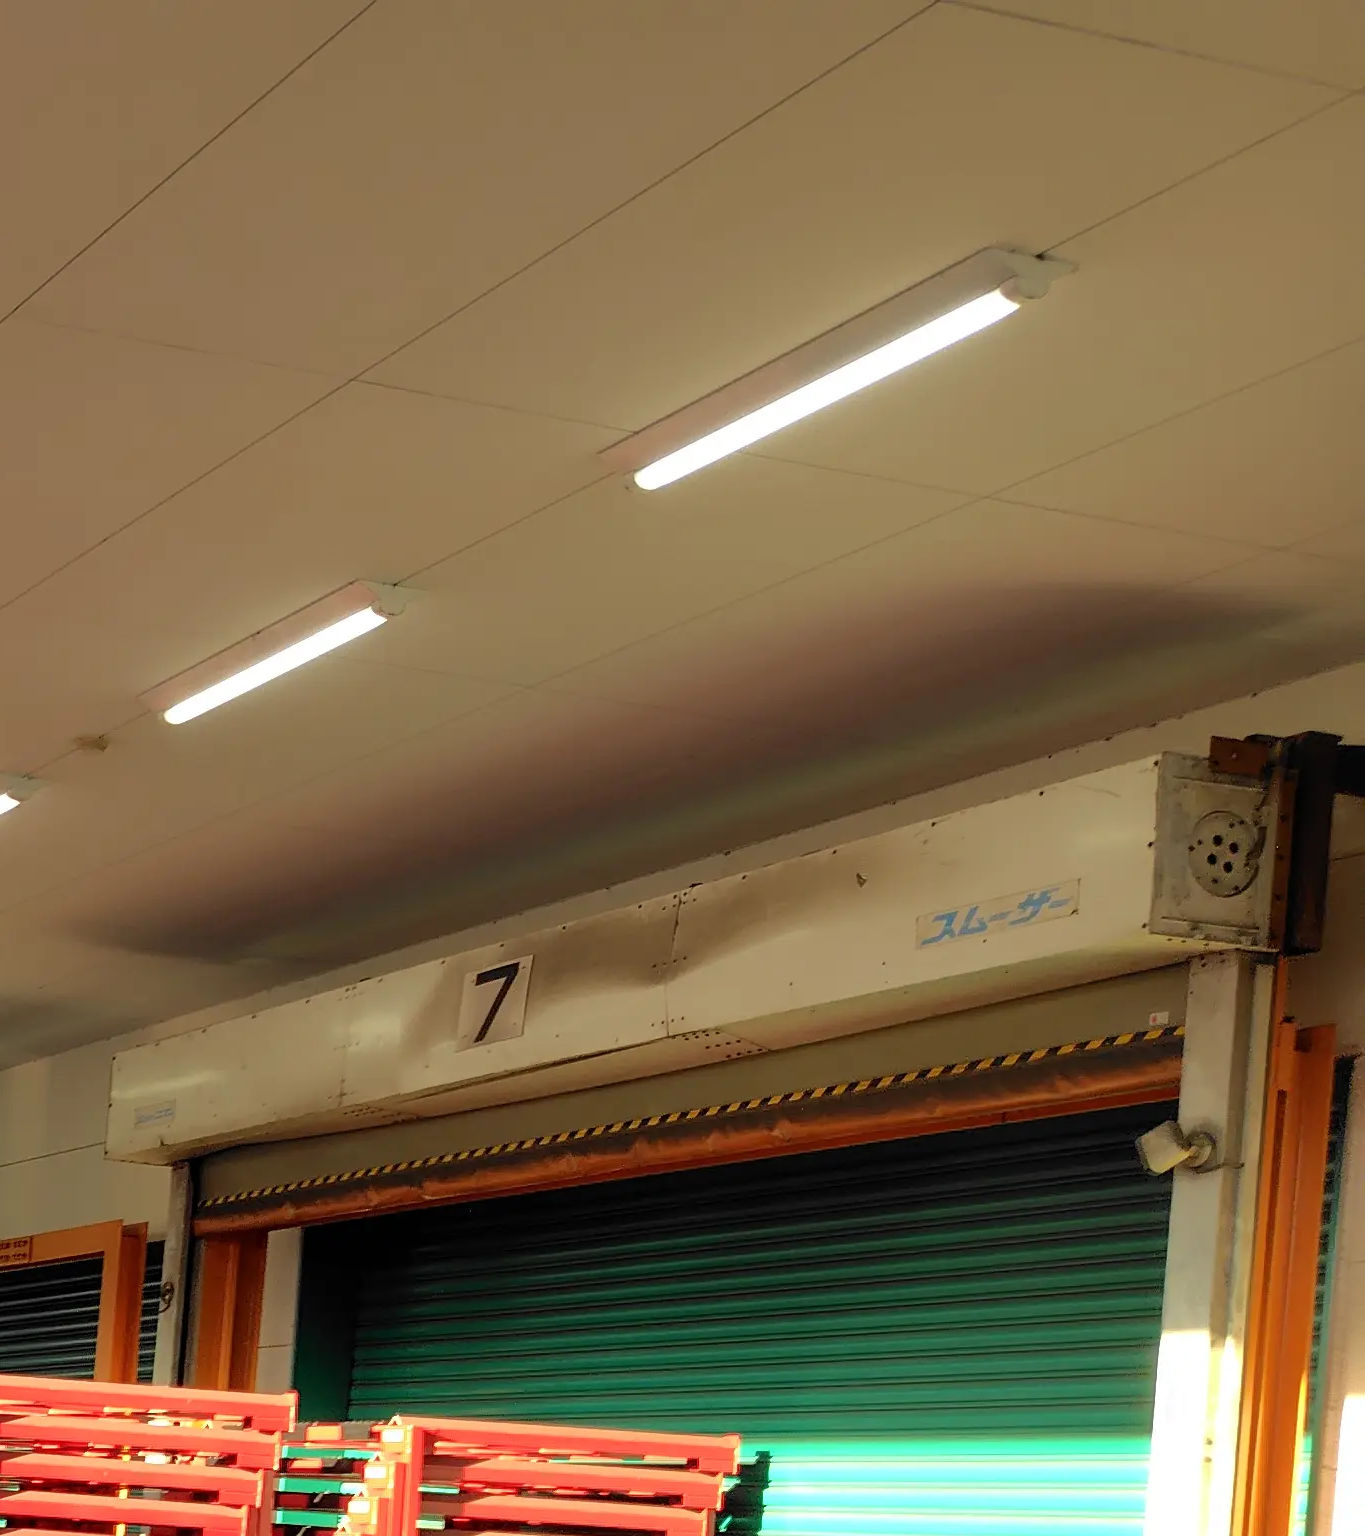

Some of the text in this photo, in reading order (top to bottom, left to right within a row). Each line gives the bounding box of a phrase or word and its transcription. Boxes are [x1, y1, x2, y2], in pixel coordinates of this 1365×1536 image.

[921, 887, 1073, 946] スムーザー
[473, 961, 521, 1044] 7
